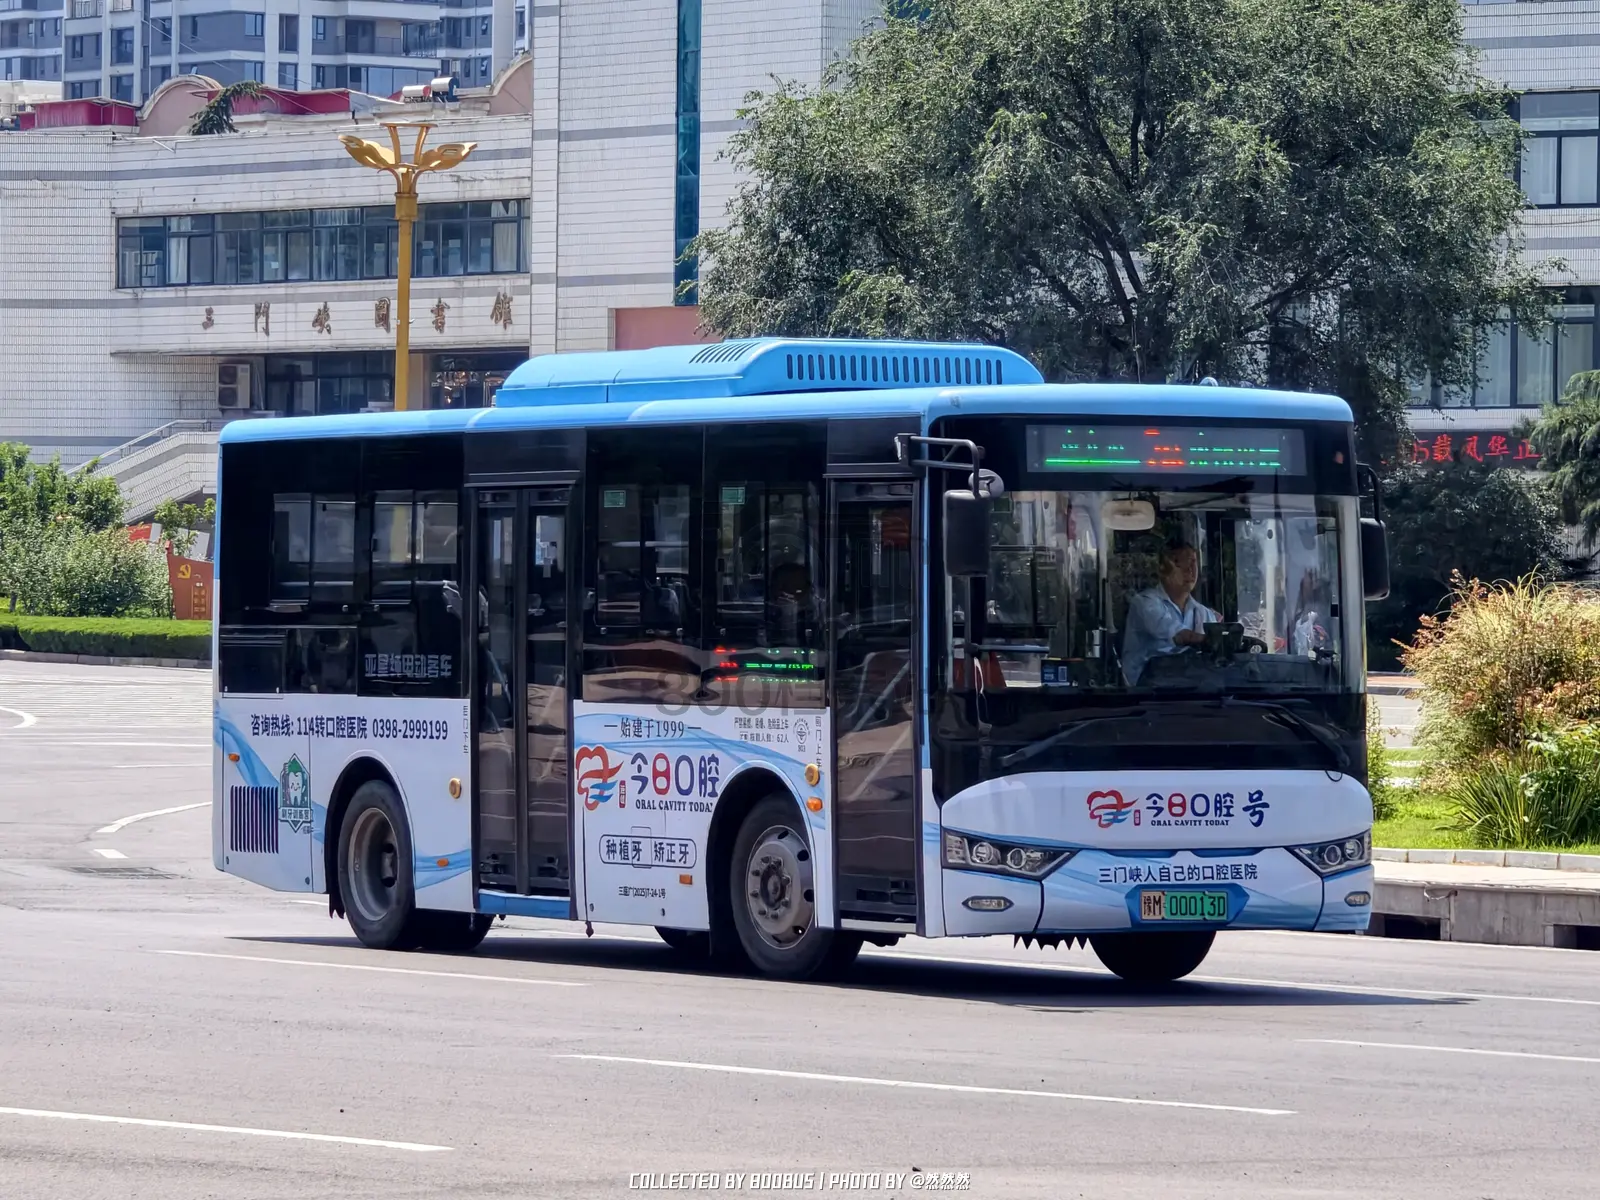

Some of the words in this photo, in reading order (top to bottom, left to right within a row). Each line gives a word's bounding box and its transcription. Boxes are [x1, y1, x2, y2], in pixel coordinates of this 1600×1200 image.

[372, 718, 448, 740] 0398-2999199
[630, 752, 720, 798] 今日口腔
[635, 799, 657, 810] ORAL
[658, 800, 687, 812] CAVITY
[1151, 819, 1172, 827] ORAL
[1174, 819, 1202, 827] CAVITY
[1205, 819, 1230, 827] TODAY
[606, 839, 642, 862] 种植牙
[654, 841, 689, 864] 矫正牙
[1098, 863, 1258, 883] 三门峡人自己的口腔医院
